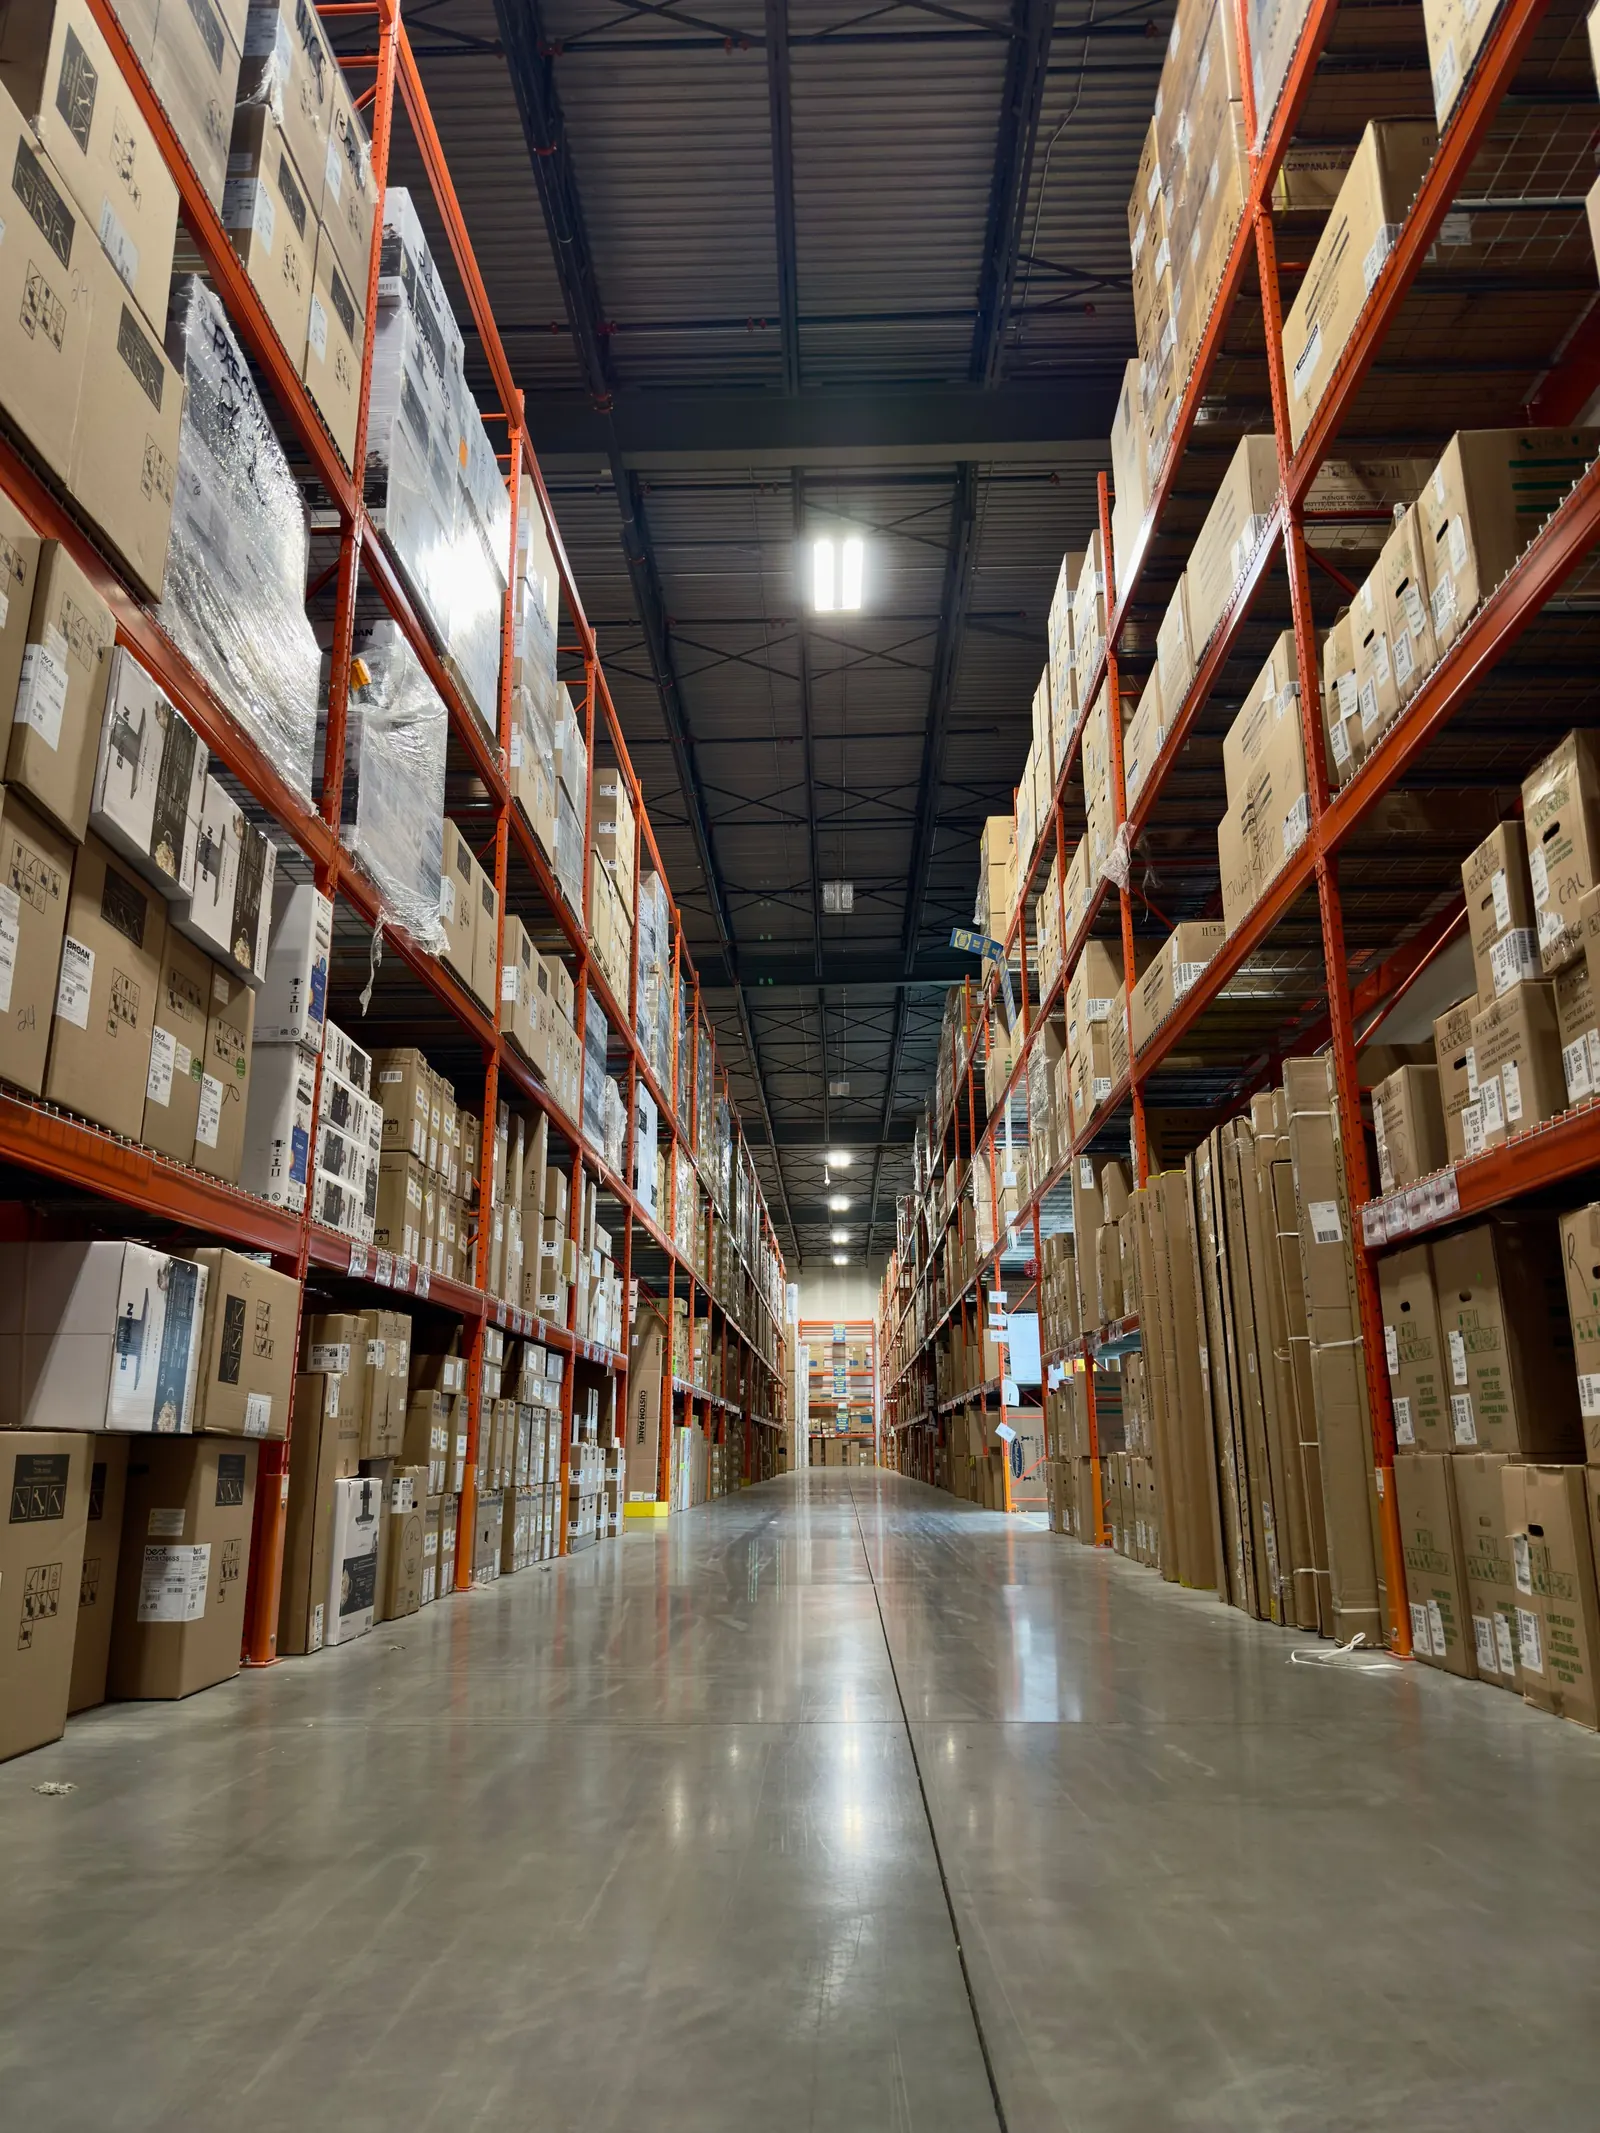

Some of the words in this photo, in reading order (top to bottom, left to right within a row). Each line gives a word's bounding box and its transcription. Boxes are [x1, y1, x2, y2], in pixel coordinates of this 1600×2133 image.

[66, 939, 91, 961] BROAN
[17, 1004, 36, 1031] 24
[638, 1389, 648, 1418] CUSTOM
[636, 1419, 647, 1445] PANEL
[146, 1546, 168, 1556] best
